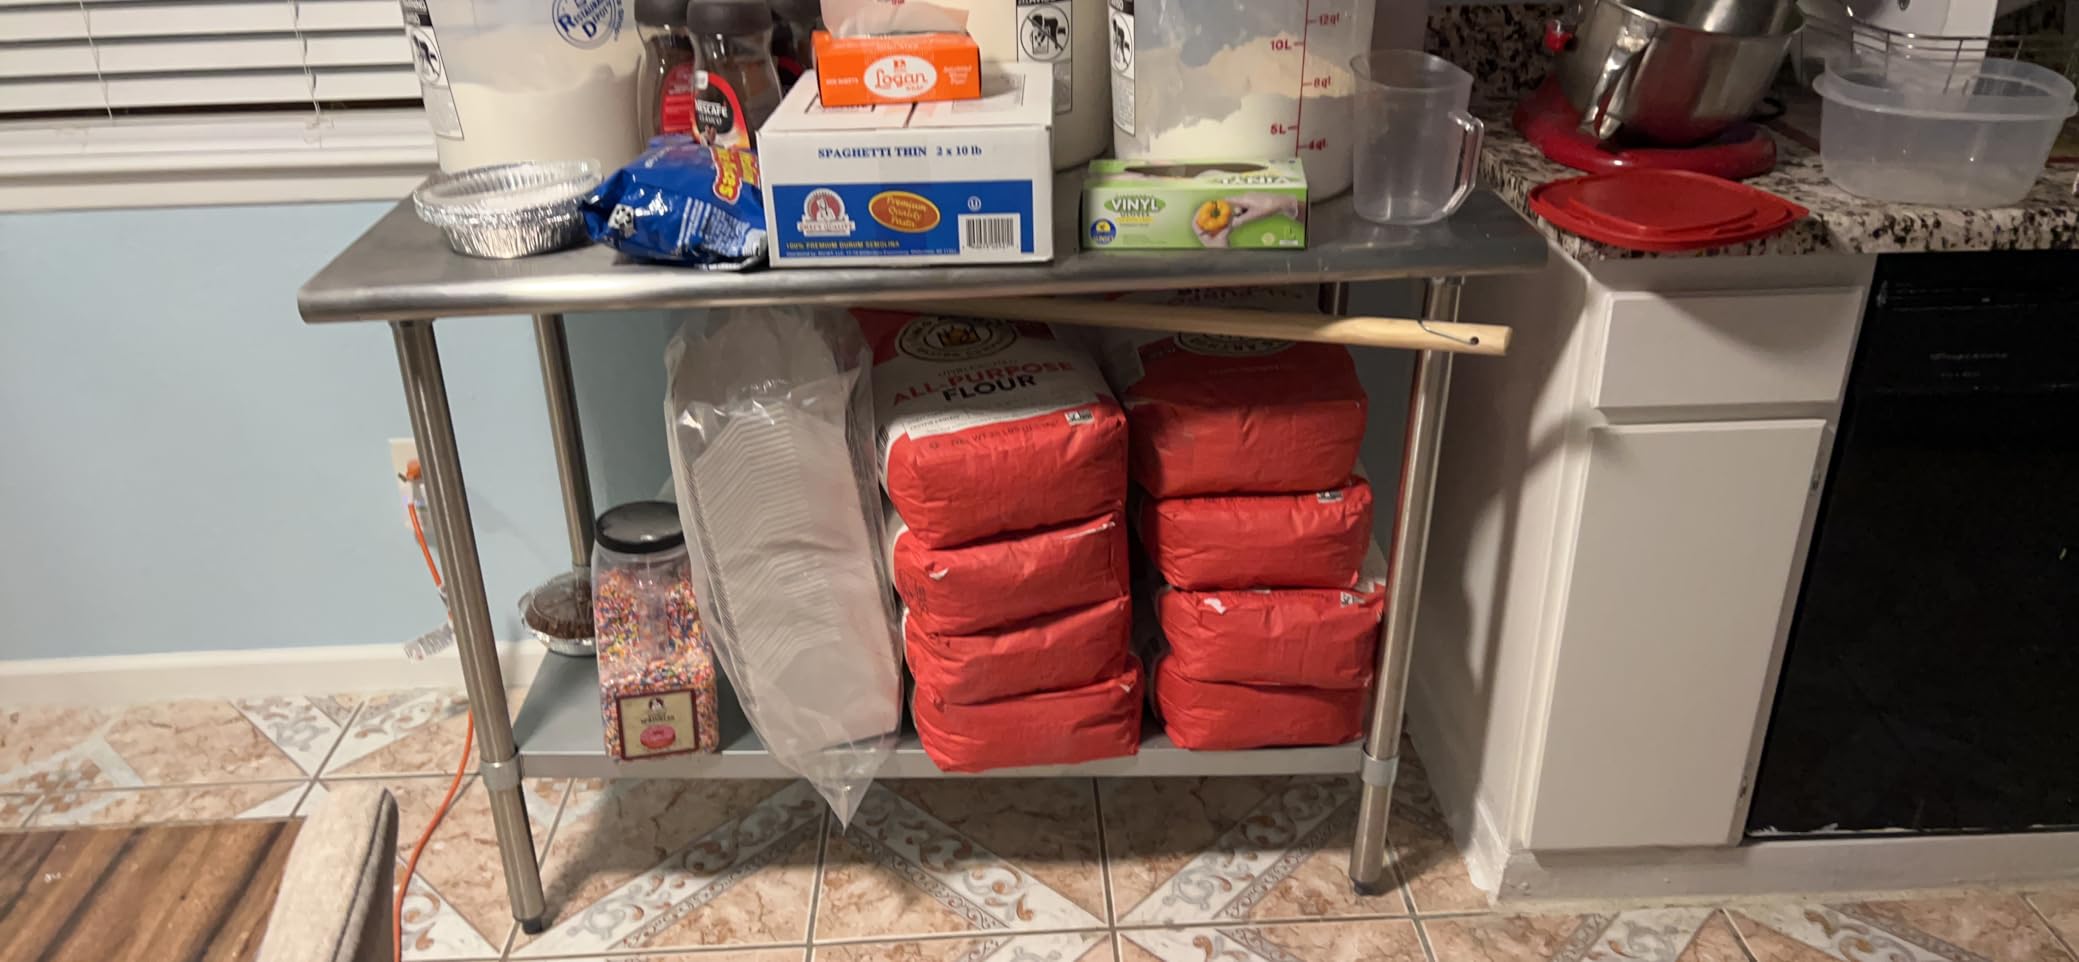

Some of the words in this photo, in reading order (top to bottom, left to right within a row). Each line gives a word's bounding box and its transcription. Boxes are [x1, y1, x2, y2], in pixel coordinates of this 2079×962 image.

[1319, 12, 1340, 26] 12qt
[1270, 39, 1292, 51] 10L
[875, 68, 928, 88] Logan
[1313, 76, 1331, 88] 8qt
[1270, 124, 1286, 135] 5L
[818, 147, 892, 159] SPAGHETTI
[894, 146, 927, 157] THIN
[936, 146, 944, 156] 2
[946, 148, 953, 156] x
[956, 146, 968, 156] 10
[971, 145, 983, 156] lb
[886, 196, 927, 213] Premium
[1111, 199, 1159, 211] VINYL
[888, 206, 922, 221] Quality
[806, 241, 838, 250] PREMIUM
[894, 361, 1073, 405] ALL-PURPOSE
[942, 374, 1037, 401] FLOUR
